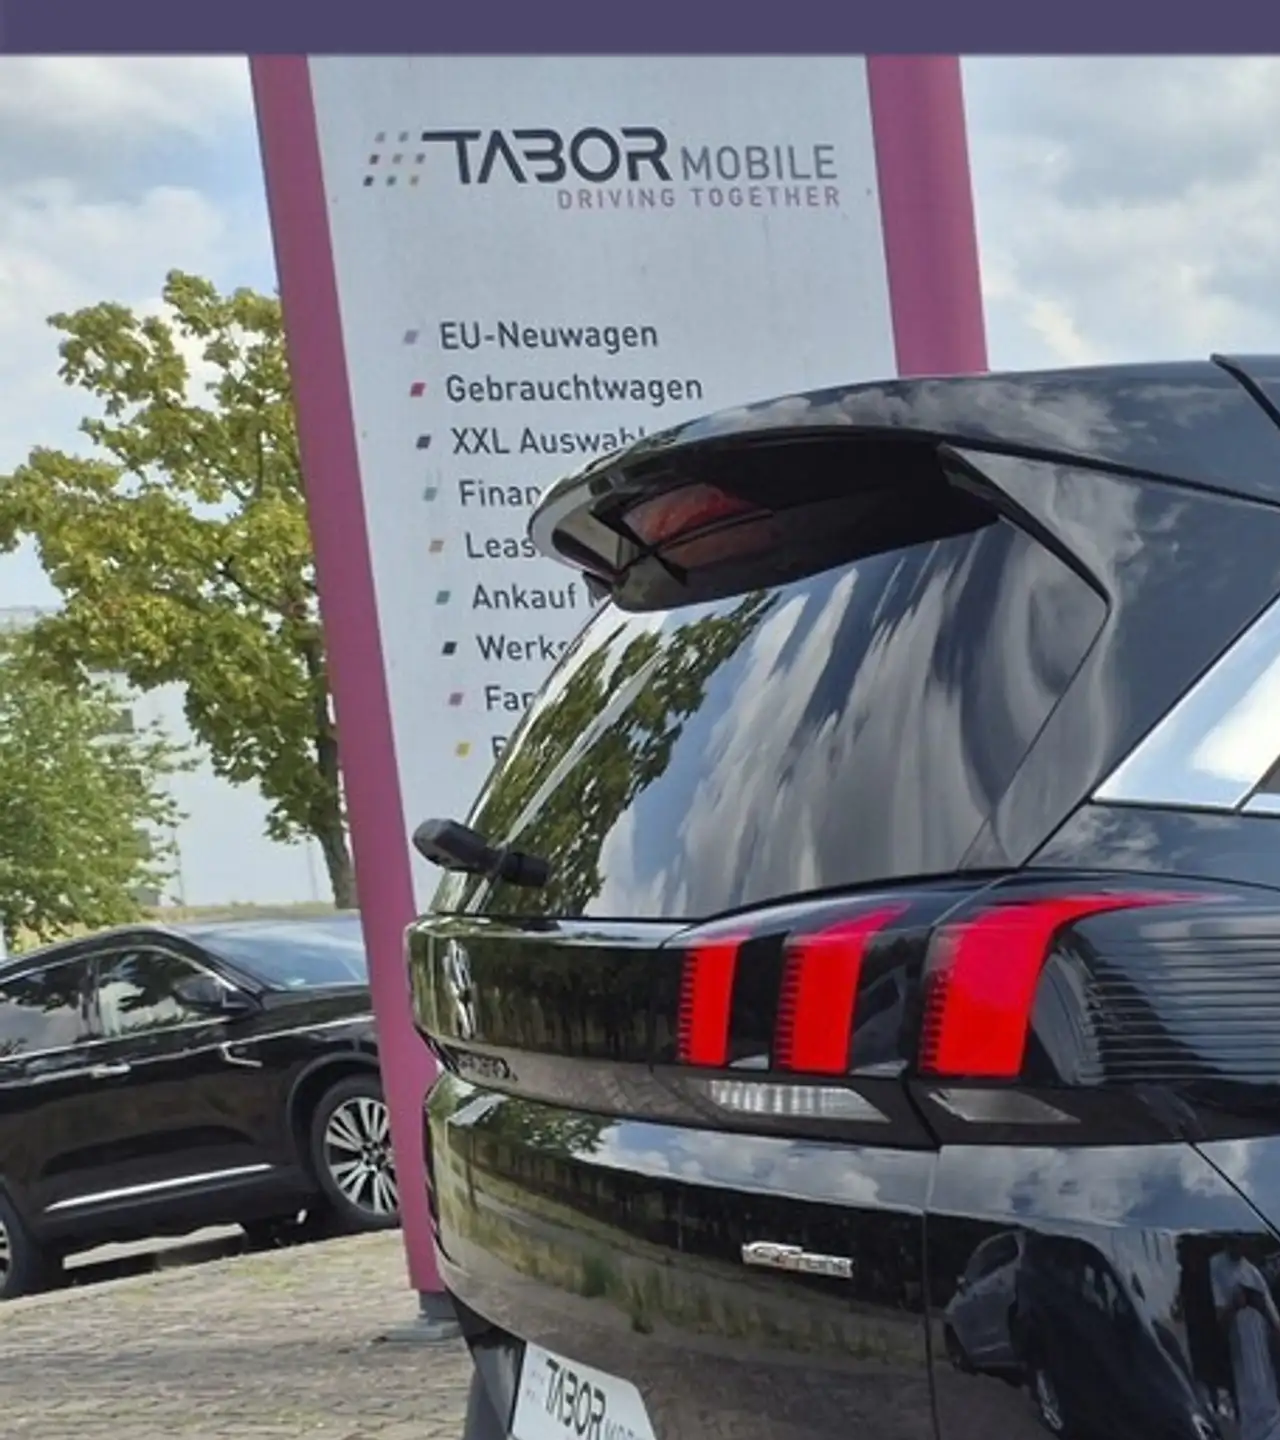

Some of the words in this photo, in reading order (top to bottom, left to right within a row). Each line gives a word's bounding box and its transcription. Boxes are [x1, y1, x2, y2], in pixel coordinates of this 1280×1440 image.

[421, 126, 673, 184] TABOR
[680, 144, 839, 182] MOBILE
[557, 187, 676, 210] DRIVING
[689, 186, 841, 208] TOGETHER
[439, 320, 659, 355] EU-Neuwagen
[446, 373, 704, 407] Gebrauchtwagen
[451, 427, 511, 455] XXL
[472, 582, 576, 609] Ankauf
